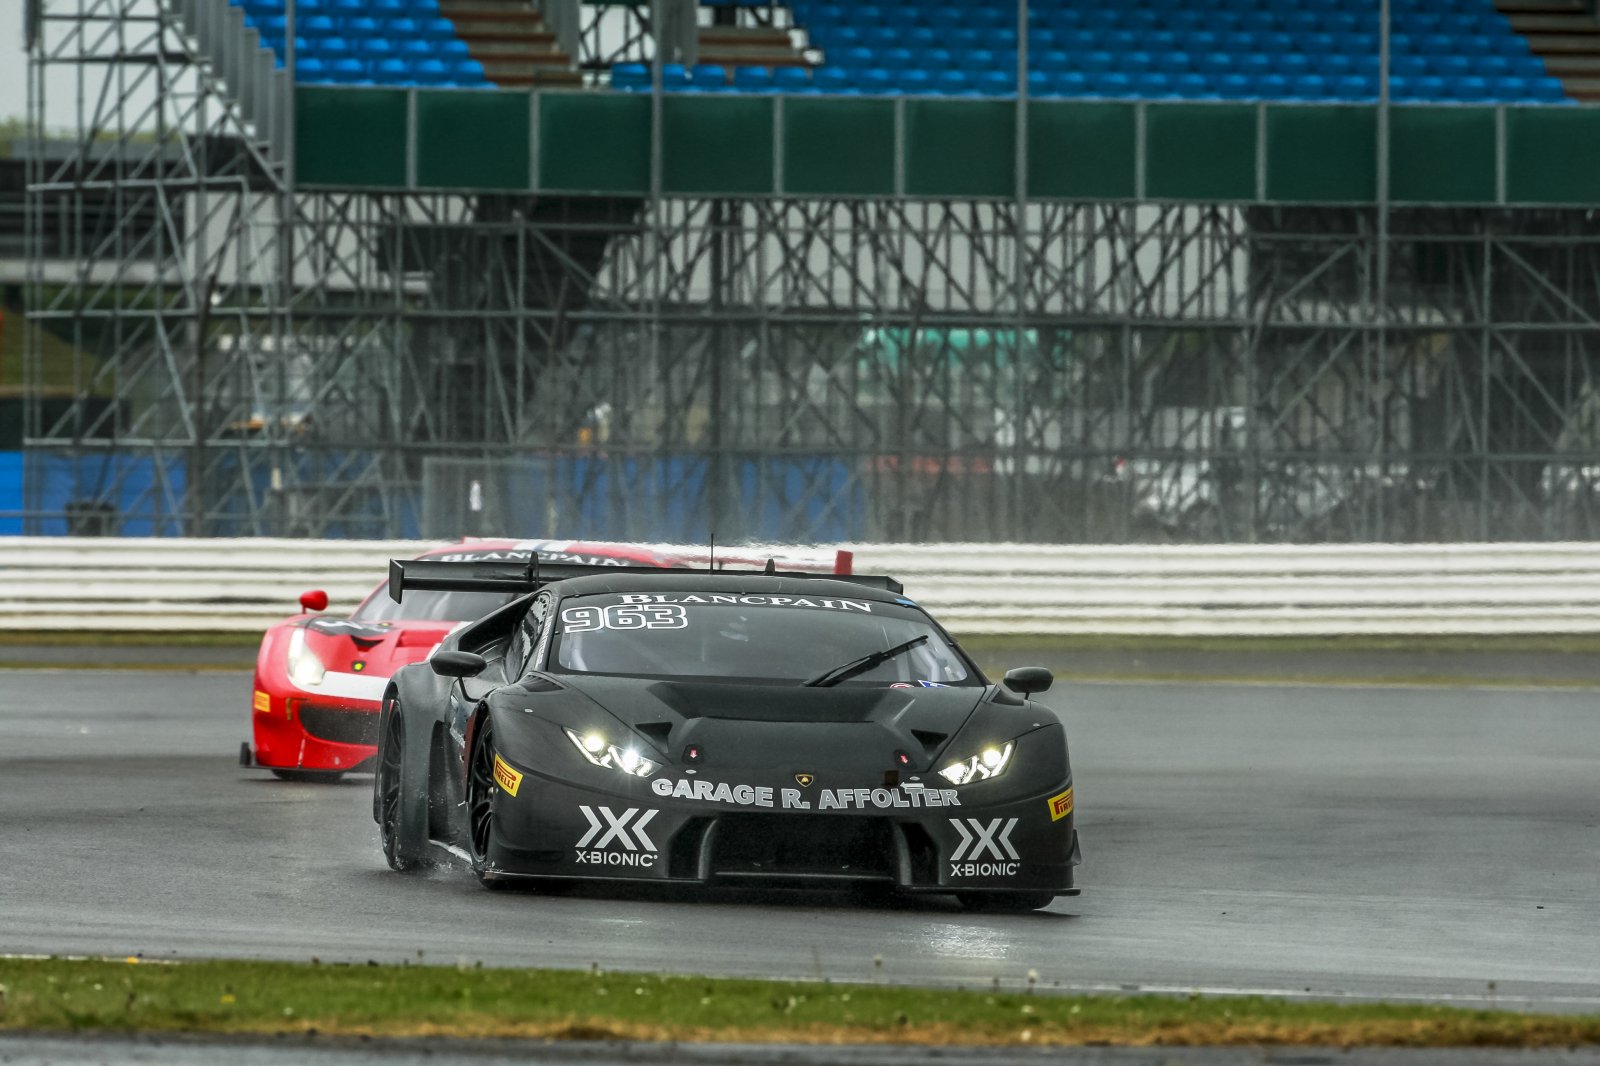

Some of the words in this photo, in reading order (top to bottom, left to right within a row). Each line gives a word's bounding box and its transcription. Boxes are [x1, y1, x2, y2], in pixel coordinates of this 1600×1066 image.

[620, 594, 873, 613] BLANCPAIN
[561, 604, 688, 633] 963
[651, 778, 774, 807] GARAGE
[781, 788, 811, 810] R.
[818, 782, 962, 810] AFFOLTER
